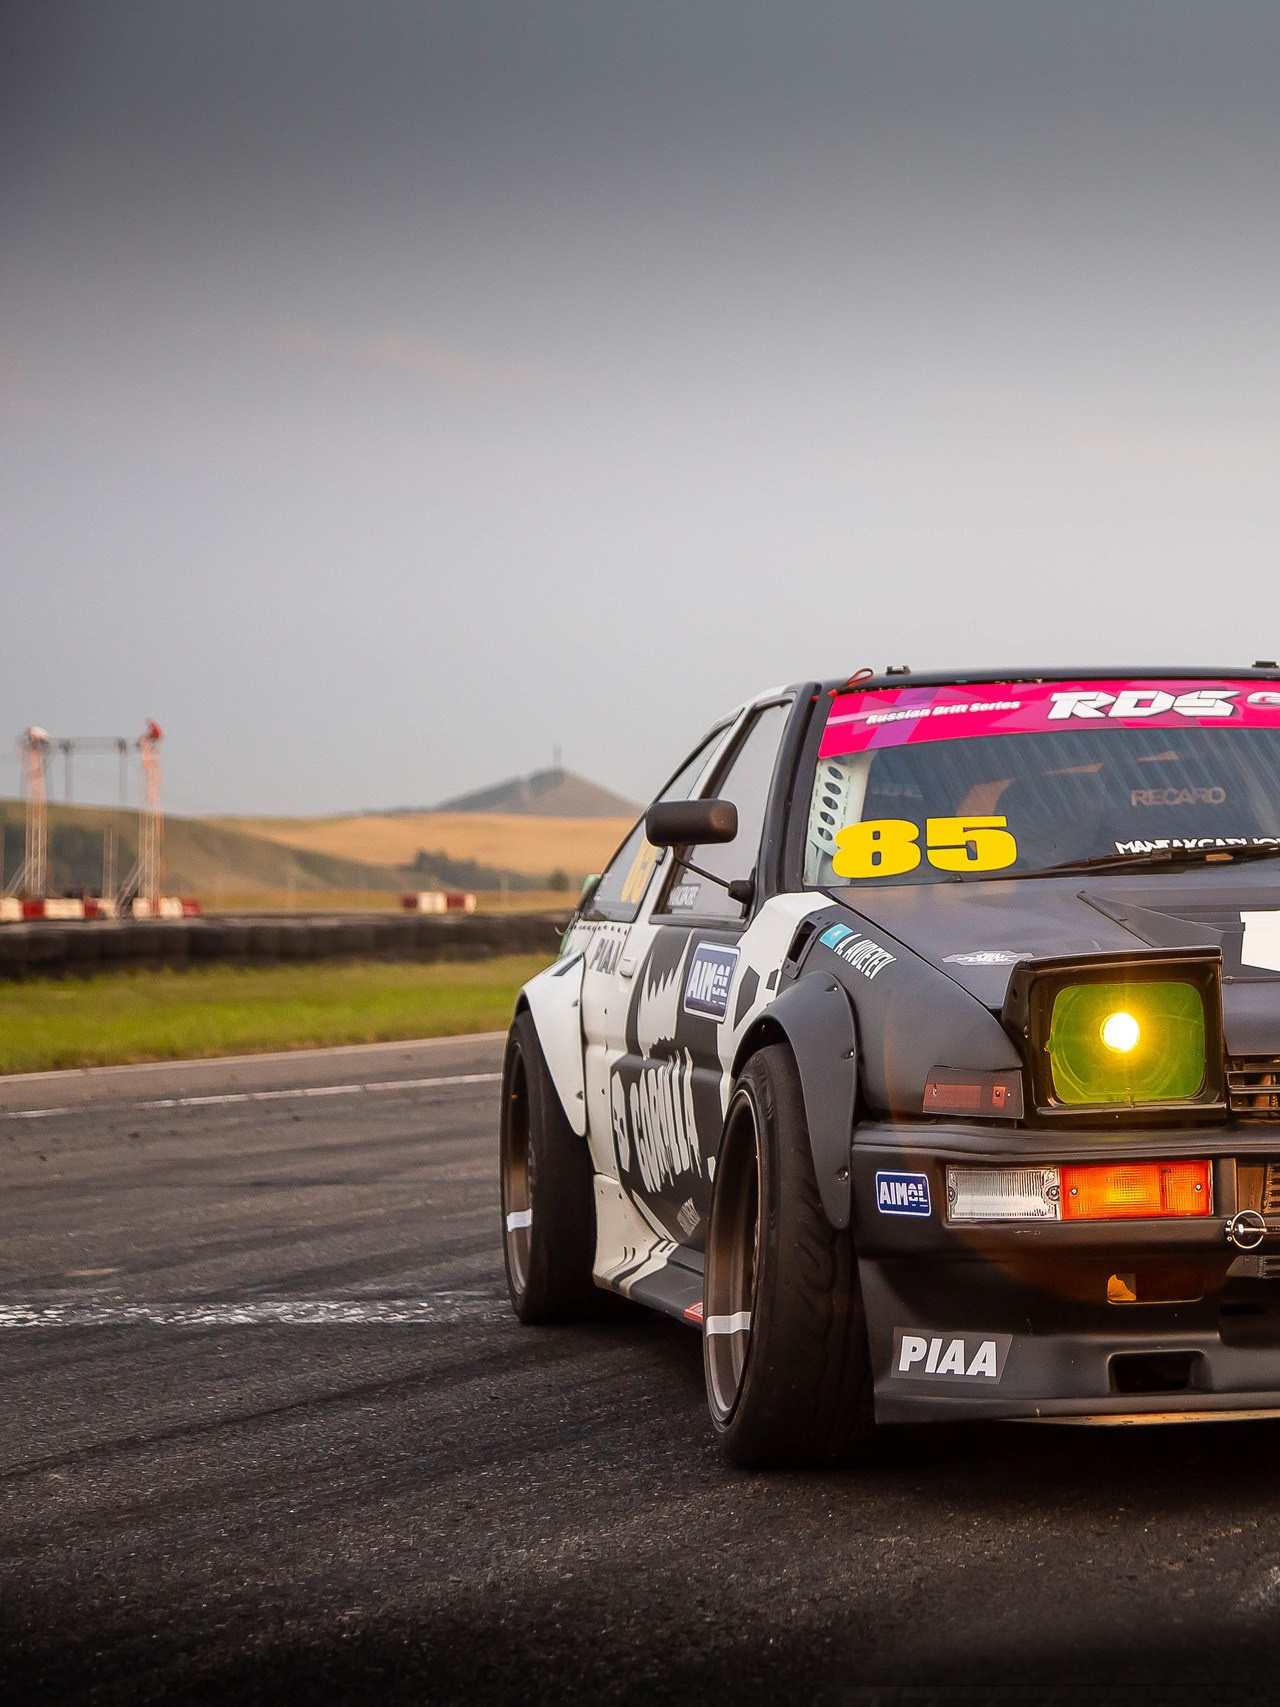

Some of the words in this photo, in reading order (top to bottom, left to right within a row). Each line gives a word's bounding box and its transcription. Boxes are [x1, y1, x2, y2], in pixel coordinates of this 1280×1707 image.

[866, 708, 931, 725] Russian
[932, 704, 968, 716] Drift
[969, 701, 1021, 713] Series
[1047, 690, 1240, 719] RDS
[1131, 786, 1226, 806] RECARO
[832, 816, 1018, 879] 85
[833, 933, 862, 956] A.
[842, 939, 898, 980] AVDEYEV
[687, 960, 731, 1006] AIMOL
[880, 1181, 928, 1207] AIMOL
[898, 1335, 997, 1377] PIAA
